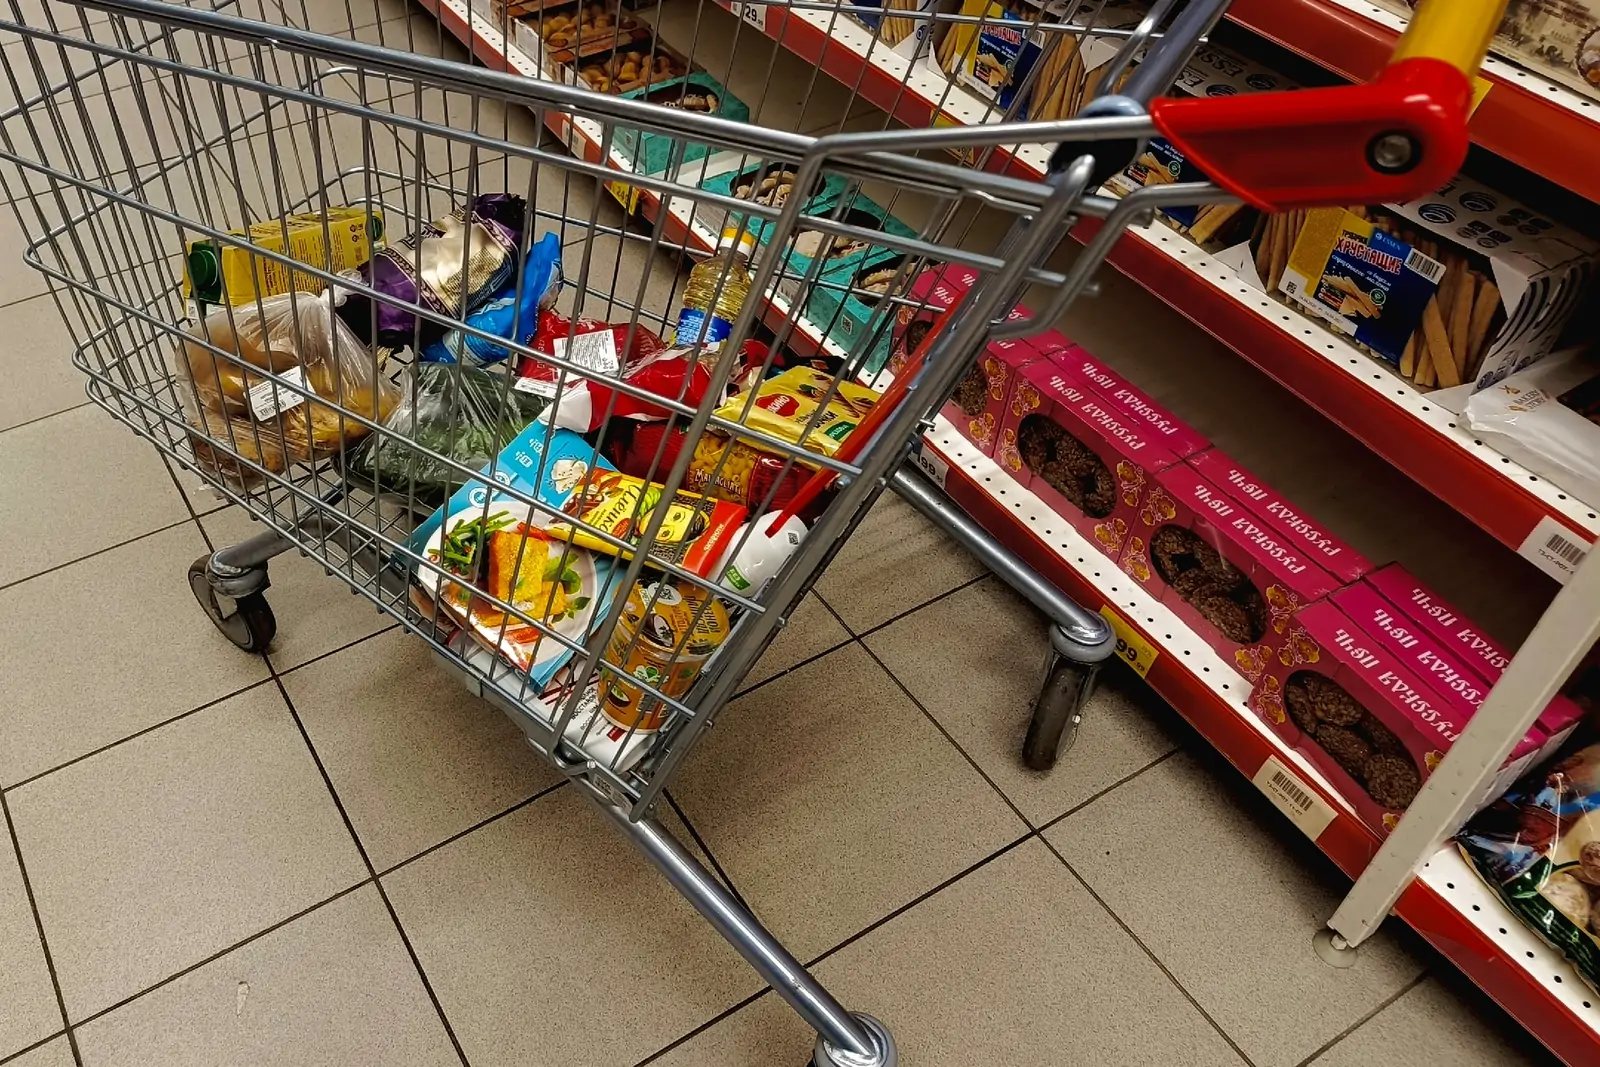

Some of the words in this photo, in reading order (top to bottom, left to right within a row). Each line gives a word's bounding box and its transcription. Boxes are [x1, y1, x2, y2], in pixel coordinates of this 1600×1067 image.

[1334, 237, 1403, 275] ХРУСТЯЩИЕ
[1050, 375, 1083, 403] ПЕЧЬ
[1082, 362, 1115, 390] ПЕЧЬ
[1081, 403, 1146, 451] РУССКАЯ
[1114, 389, 1179, 436] РУССКАЯ
[695, 468, 742, 495] MALAGLIATI
[1194, 485, 1234, 517] ПЕЧЬ
[1228, 469, 1268, 501] ПЕЧЬ
[1232, 518, 1306, 574] РУССКАЯ
[1266, 501, 1342, 556] РУССКАЯ
[1412, 588, 1457, 627] ПЕЧЬ
[1373, 608, 1419, 648] ПЕЧЬ
[1334, 628, 1380, 669] ПЕЧЬ
[1456, 629, 1509, 674] СКАЯ
[1417, 650, 1484, 709] УССКАЯ
[1378, 671, 1461, 742] РУССКАЯ
